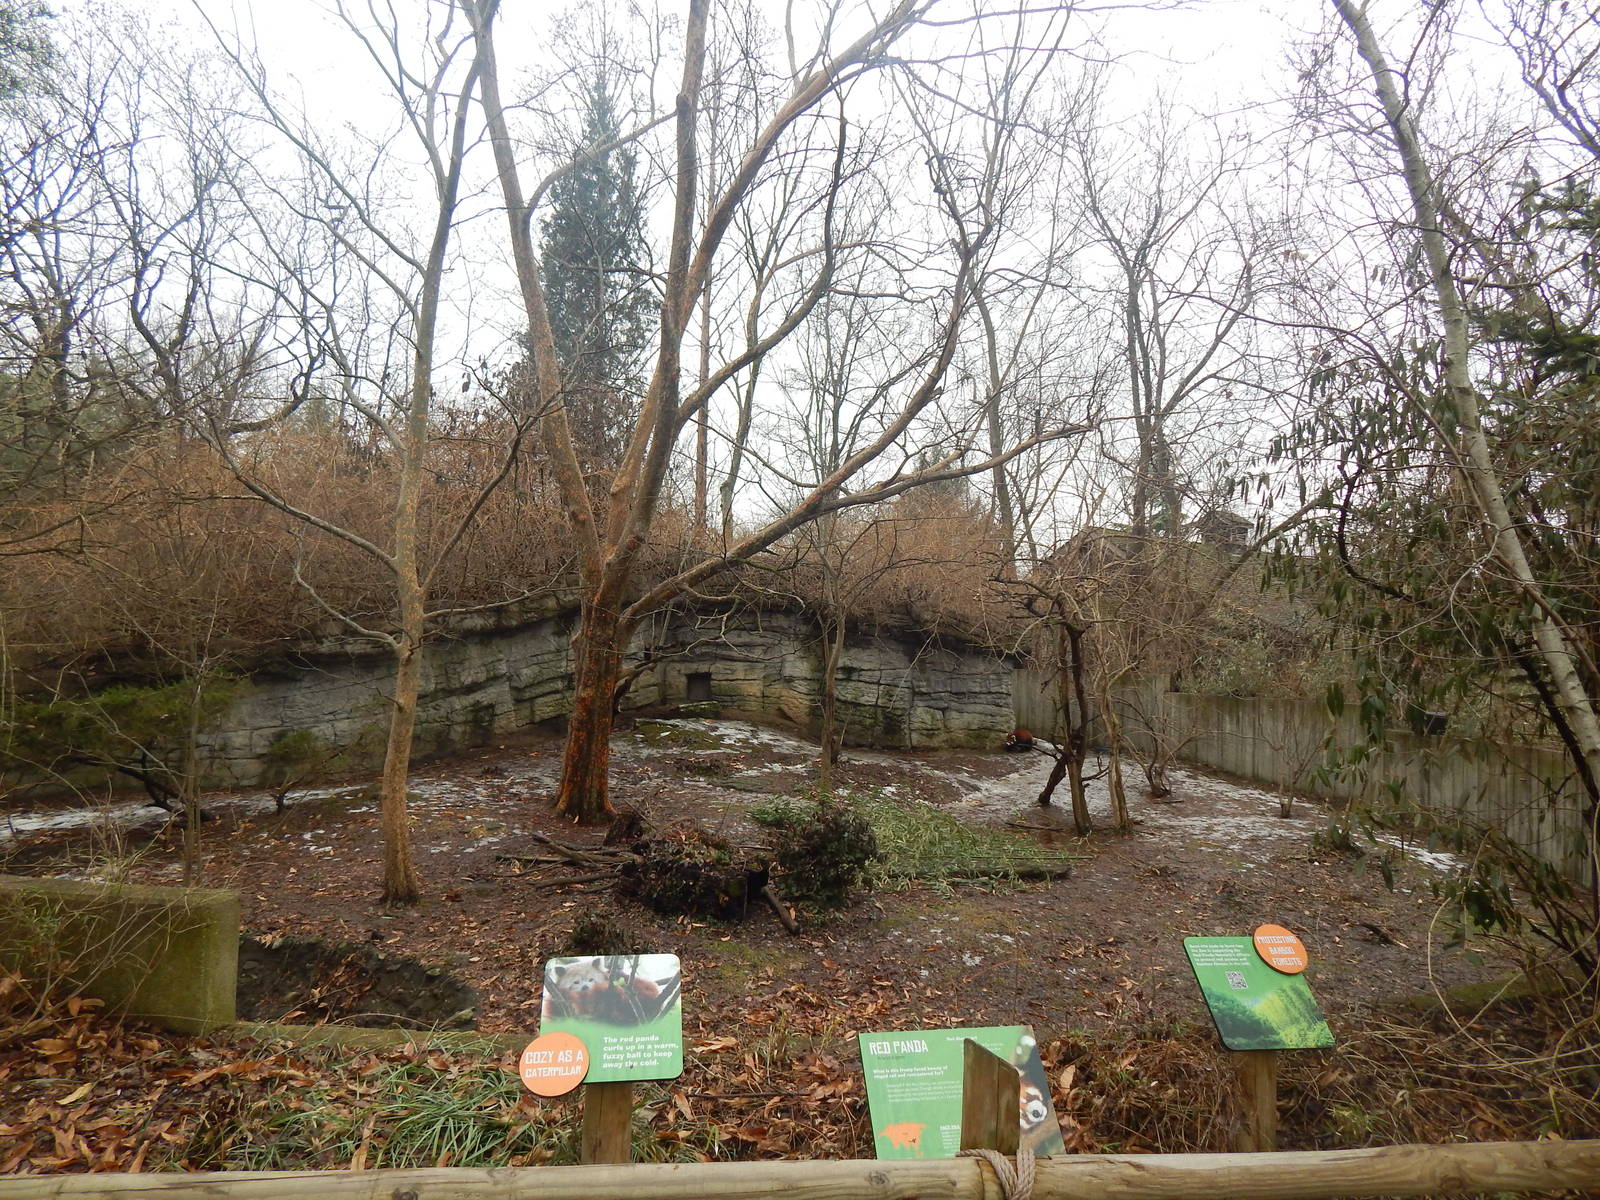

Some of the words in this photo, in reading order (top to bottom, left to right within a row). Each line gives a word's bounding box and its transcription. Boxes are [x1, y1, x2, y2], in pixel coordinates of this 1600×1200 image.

[635, 1034, 659, 1042] panda
[869, 1042, 890, 1055] RED
[893, 1040, 928, 1054] PANDA
[525, 1051, 552, 1064] COZY
[557, 1050, 572, 1063] AS
[576, 1050, 584, 1062] A
[525, 1066, 581, 1078] CATERPILLAR
